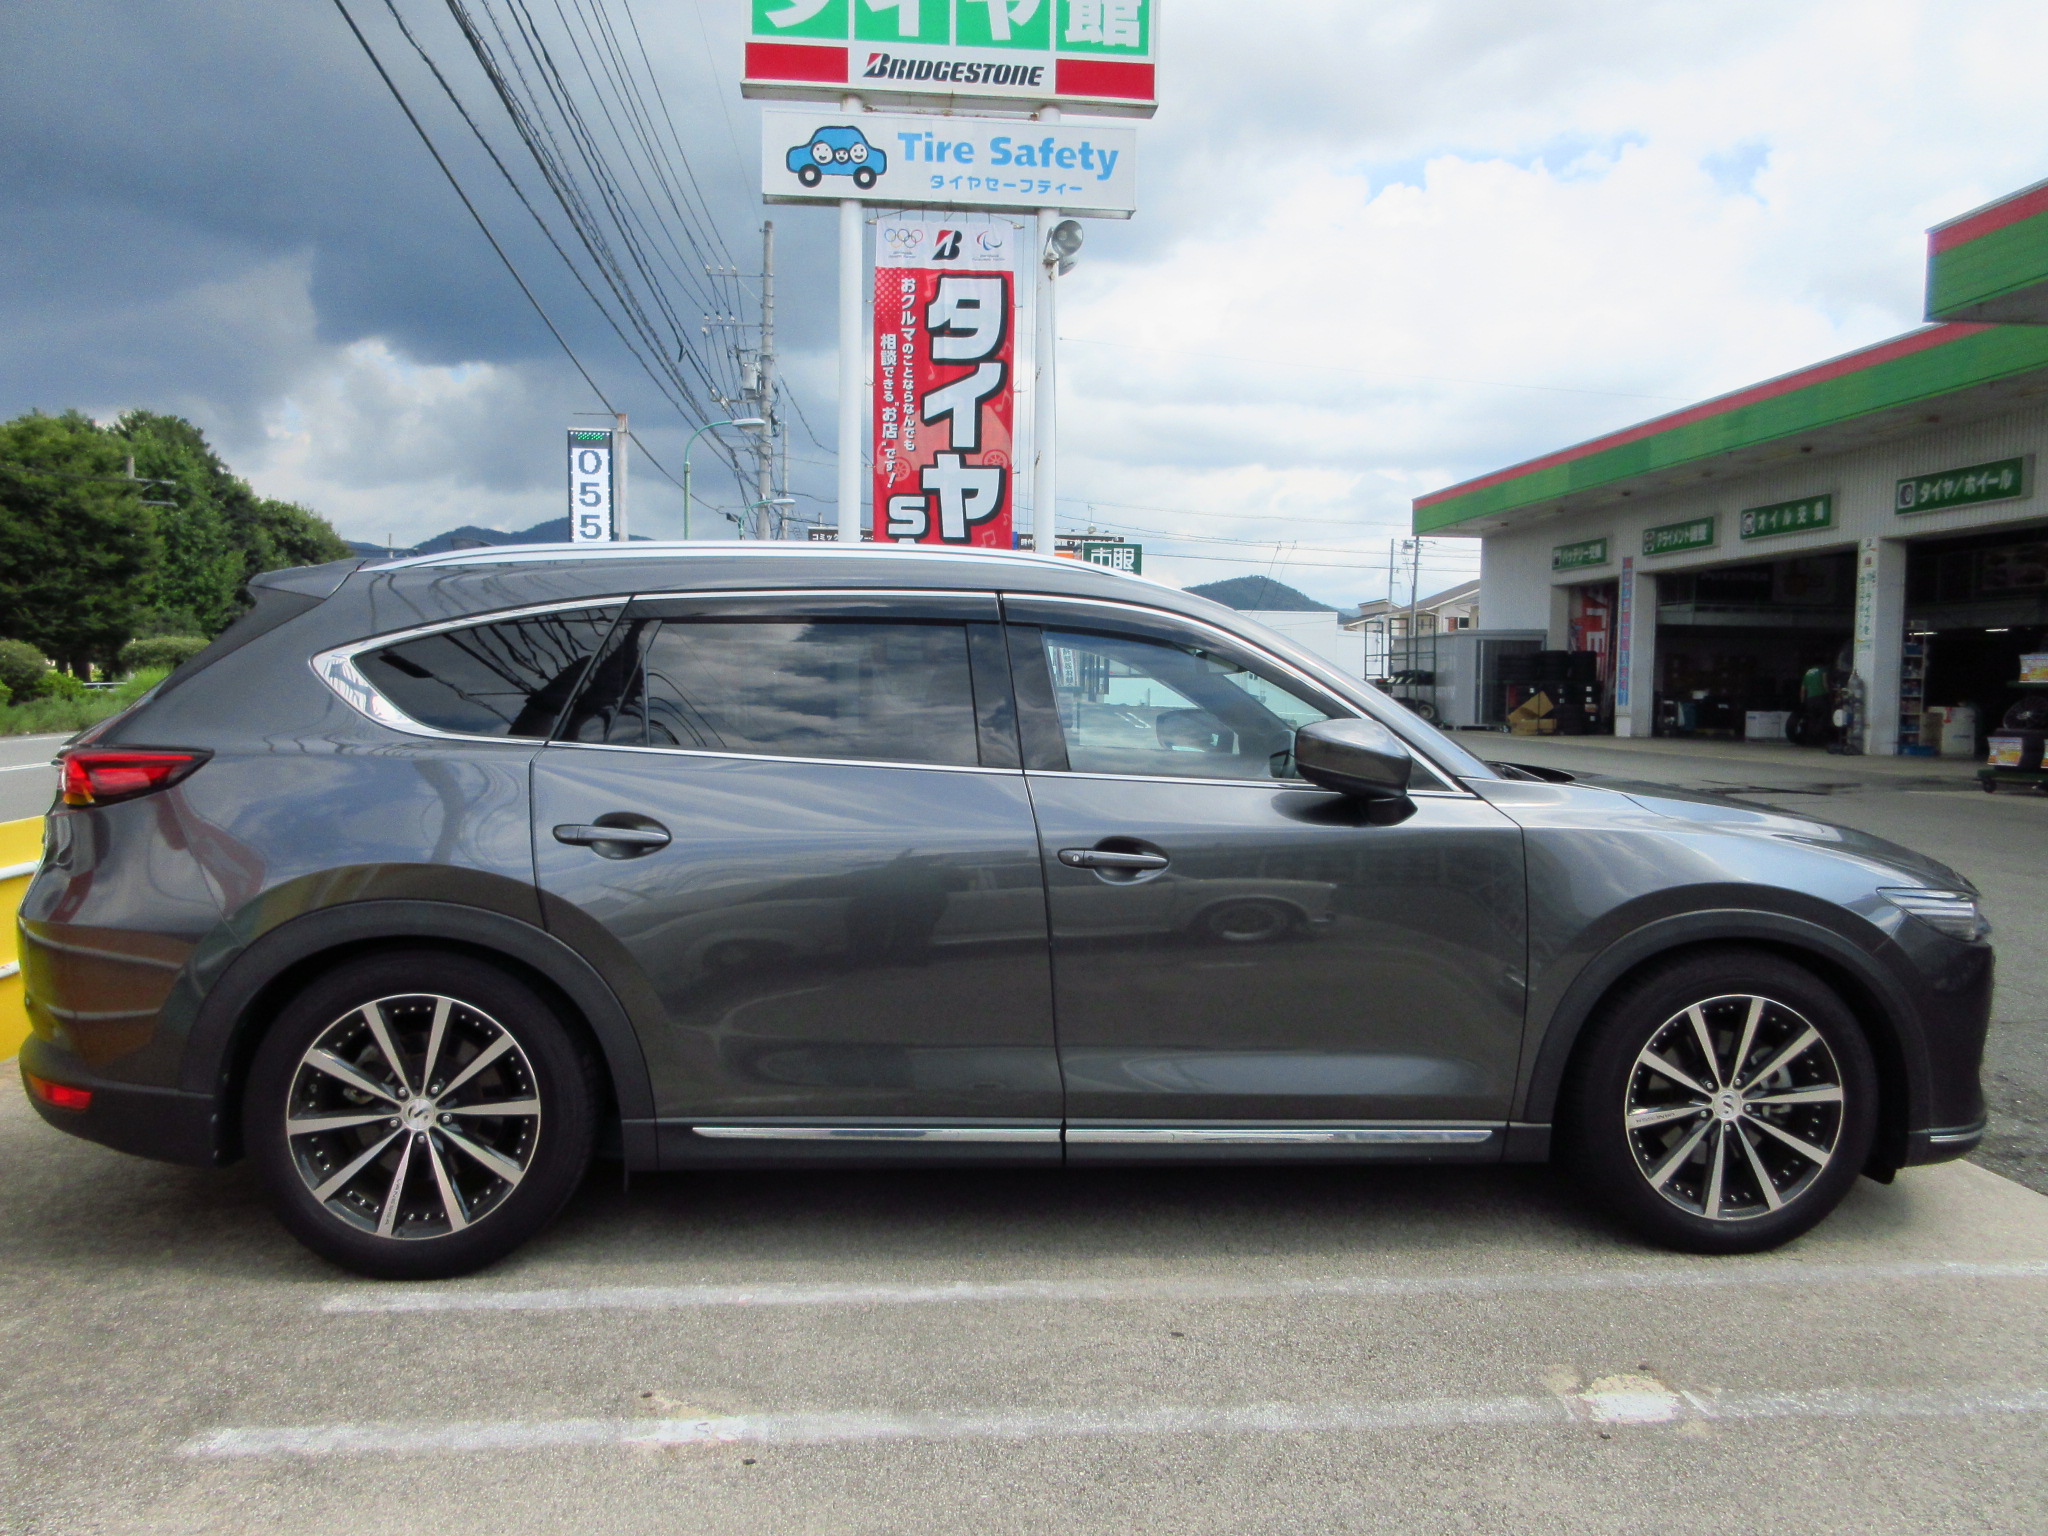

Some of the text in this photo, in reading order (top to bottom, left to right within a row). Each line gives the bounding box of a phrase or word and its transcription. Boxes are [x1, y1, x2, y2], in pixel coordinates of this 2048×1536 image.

[863, 53, 1045, 86] BRIDGESTONE
[897, 131, 1119, 181] Tire Safety
[930, 174, 1083, 195] タイヤセーフティー
[901, 278, 916, 451] おクルマのことならなんでも
[923, 275, 1004, 540] タイヤ
[578, 450, 602, 540] 055
